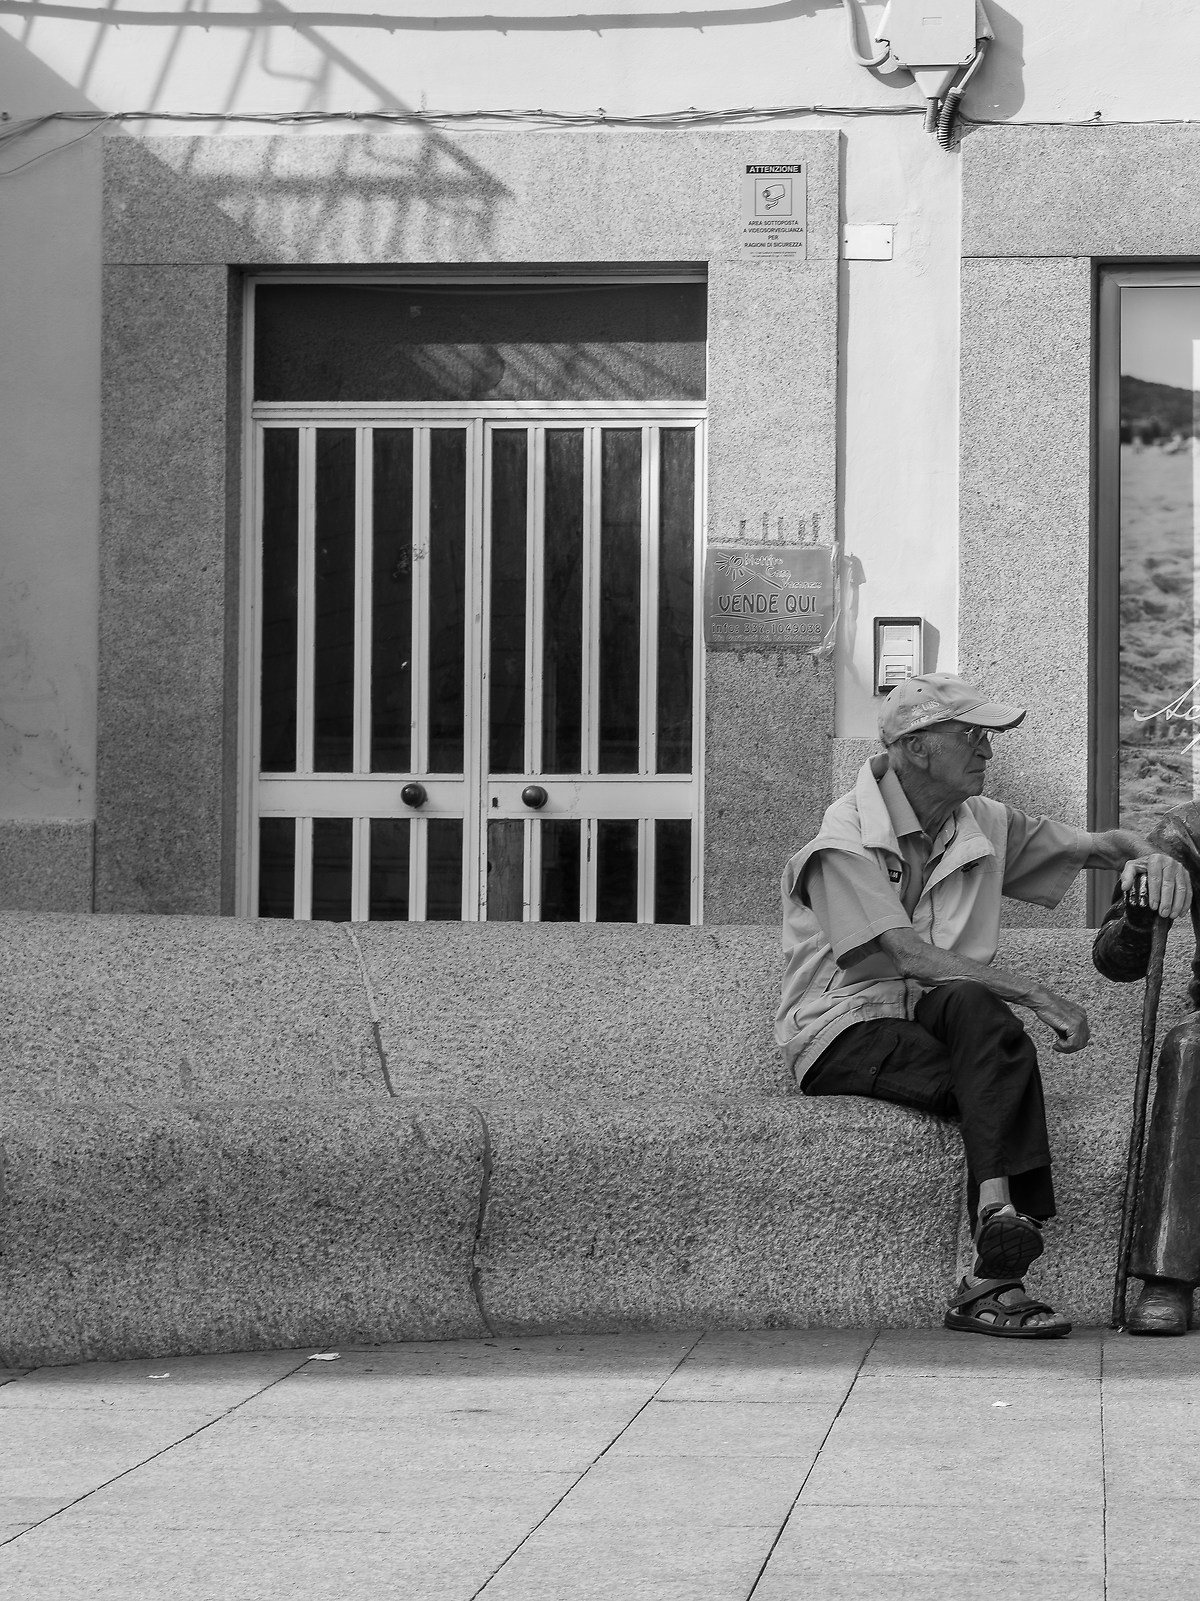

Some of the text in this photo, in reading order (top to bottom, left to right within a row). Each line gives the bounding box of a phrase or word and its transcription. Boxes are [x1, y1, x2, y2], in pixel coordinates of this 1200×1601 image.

[748, 165, 799, 173] ATTENZIONE
[719, 594, 817, 614] VENDE QUI
[711, 622, 740, 634] info:
